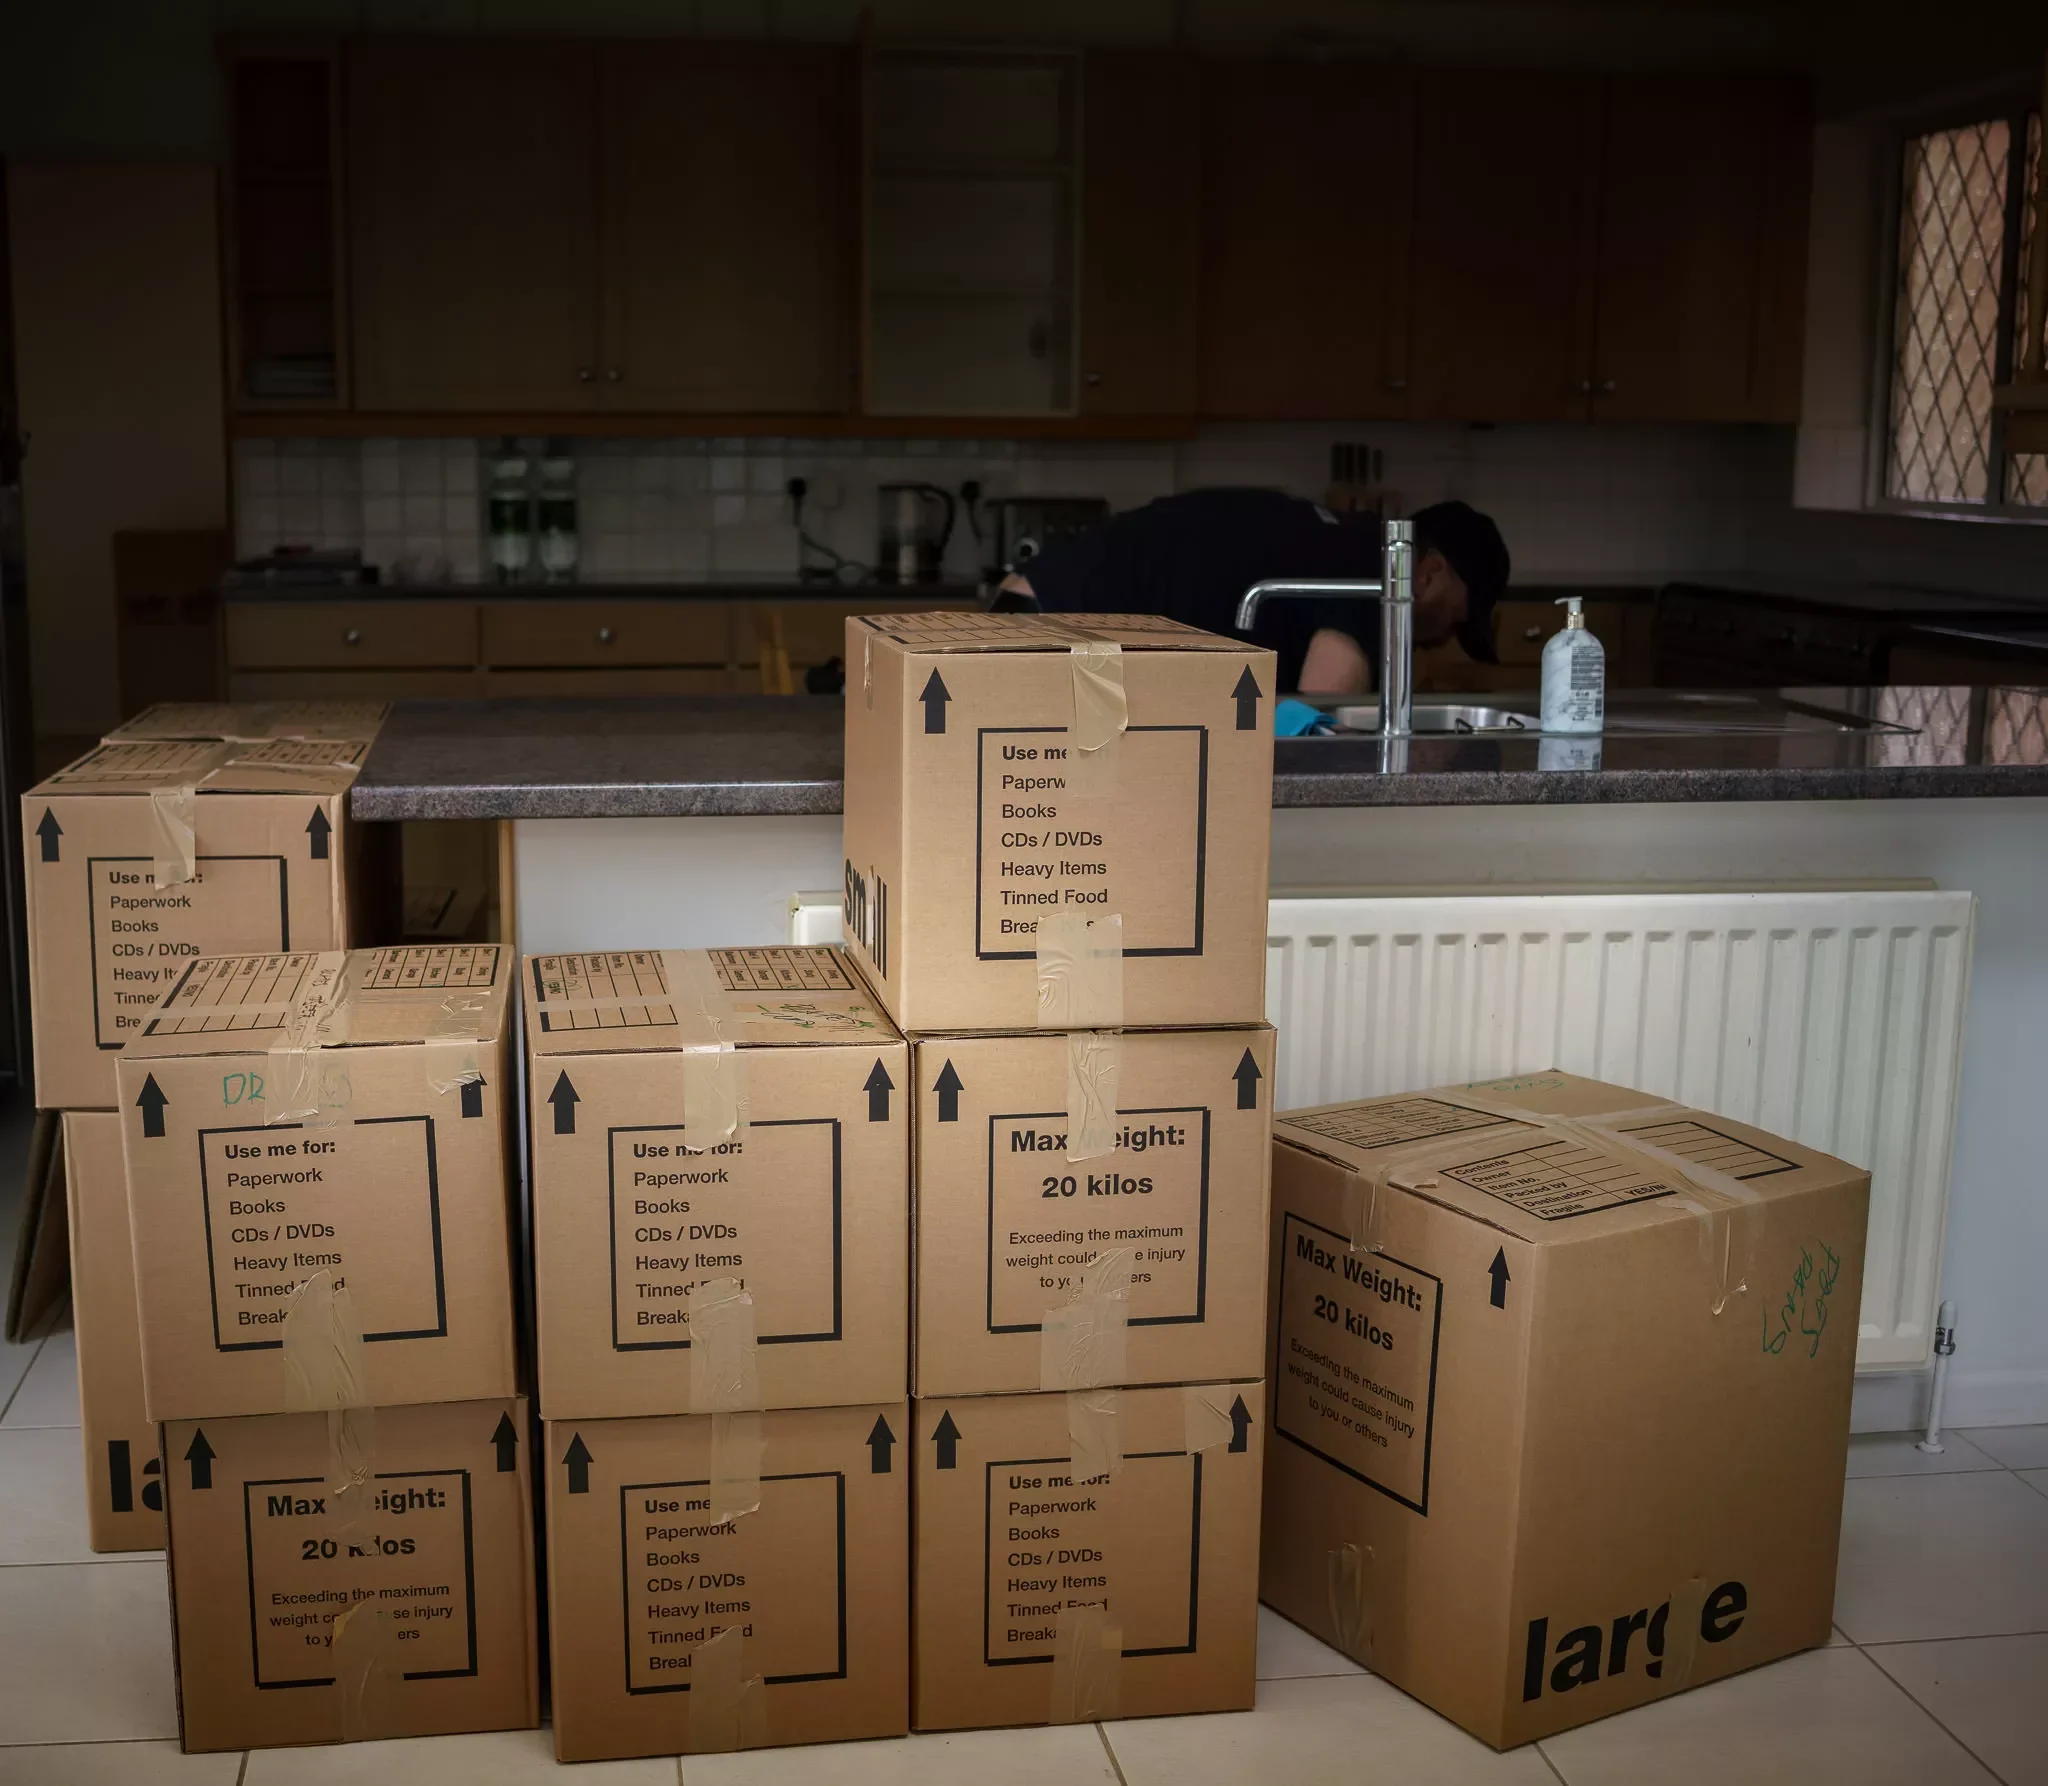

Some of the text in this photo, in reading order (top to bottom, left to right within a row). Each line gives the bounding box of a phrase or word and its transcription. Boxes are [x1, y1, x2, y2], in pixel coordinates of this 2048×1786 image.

[1003, 746, 1037, 760] Use
[1003, 775, 1065, 792] Paperw
[1003, 804, 1056, 818] Books
[1002, 833, 1037, 847] CDs
[1056, 832, 1102, 846] DVDs
[110, 872, 139, 884] Use
[1002, 861, 1106, 879] Heavy Items
[111, 896, 191, 911] Paperwork
[1000, 889, 1107, 905] Tinned Food
[112, 920, 159, 932] Books
[845, 858, 887, 981] smll
[113, 944, 144, 956] CDs
[159, 943, 200, 955] DVDs
[114, 968, 159, 983] Heavy
[1012, 1125, 1184, 1152] Max eight:
[225, 1140, 335, 1159] Use me for:
[634, 1144, 669, 1158] Use
[1454, 1158, 1510, 1176] Contents
[228, 1168, 323, 1189] Paperwork
[635, 1169, 728, 1188] Paperwork
[1471, 1170, 1511, 1183] Owner
[1487, 1179, 1517, 1191] Item
[1042, 1174, 1153, 1198] 20 kilos
[1504, 1181, 1568, 1199] Packed by
[635, 1199, 689, 1214] Books
[1523, 1188, 1593, 1208] Destination
[230, 1199, 285, 1215] Books
[1540, 1203, 1584, 1219] Fragile
[232, 1228, 268, 1243] CDs
[287, 1224, 334, 1239] DVDs
[635, 1228, 672, 1242] CDs
[690, 1225, 737, 1239] DVDs
[1010, 1226, 1182, 1244] Exceeding the maximum
[234, 1253, 341, 1271] Heavy Items
[636, 1254, 742, 1271] Heavy Items
[1006, 1254, 1053, 1268] weight
[1058, 1251, 1096, 1264] could
[1148, 1248, 1185, 1262] injury
[1297, 1234, 1422, 1312] Max Weight:
[235, 1281, 294, 1298] Tinned
[1040, 1277, 1054, 1287] to
[1314, 1295, 1393, 1350] 20 kilos
[1290, 1338, 1414, 1412] Exceeding the maximum
[1288, 1362, 1414, 1438] weight could cause injury
[1309, 1396, 1388, 1448] to you or others
[1010, 1476, 1042, 1489] Use
[268, 1496, 325, 1517] Max
[645, 1500, 710, 1513] Use me
[1009, 1498, 1096, 1517] Paperwork
[646, 1521, 736, 1542] Paperwork
[1009, 1526, 1059, 1541] Books
[302, 1539, 337, 1560] 20
[1008, 1553, 1041, 1566] CDs
[1059, 1549, 1102, 1563] DVDs
[647, 1551, 699, 1566] Books
[647, 1578, 682, 1592] CDs
[700, 1574, 745, 1588] DVDs
[1008, 1576, 1106, 1592] Heavy Items
[272, 1590, 347, 1605] Exceeding
[380, 1585, 449, 1598] maximum
[270, 1614, 318, 1627] weight
[414, 1606, 453, 1620] injury
[648, 1601, 750, 1619] Heavy Items
[305, 1635, 320, 1645] to
[648, 1628, 704, 1644] Tinned
